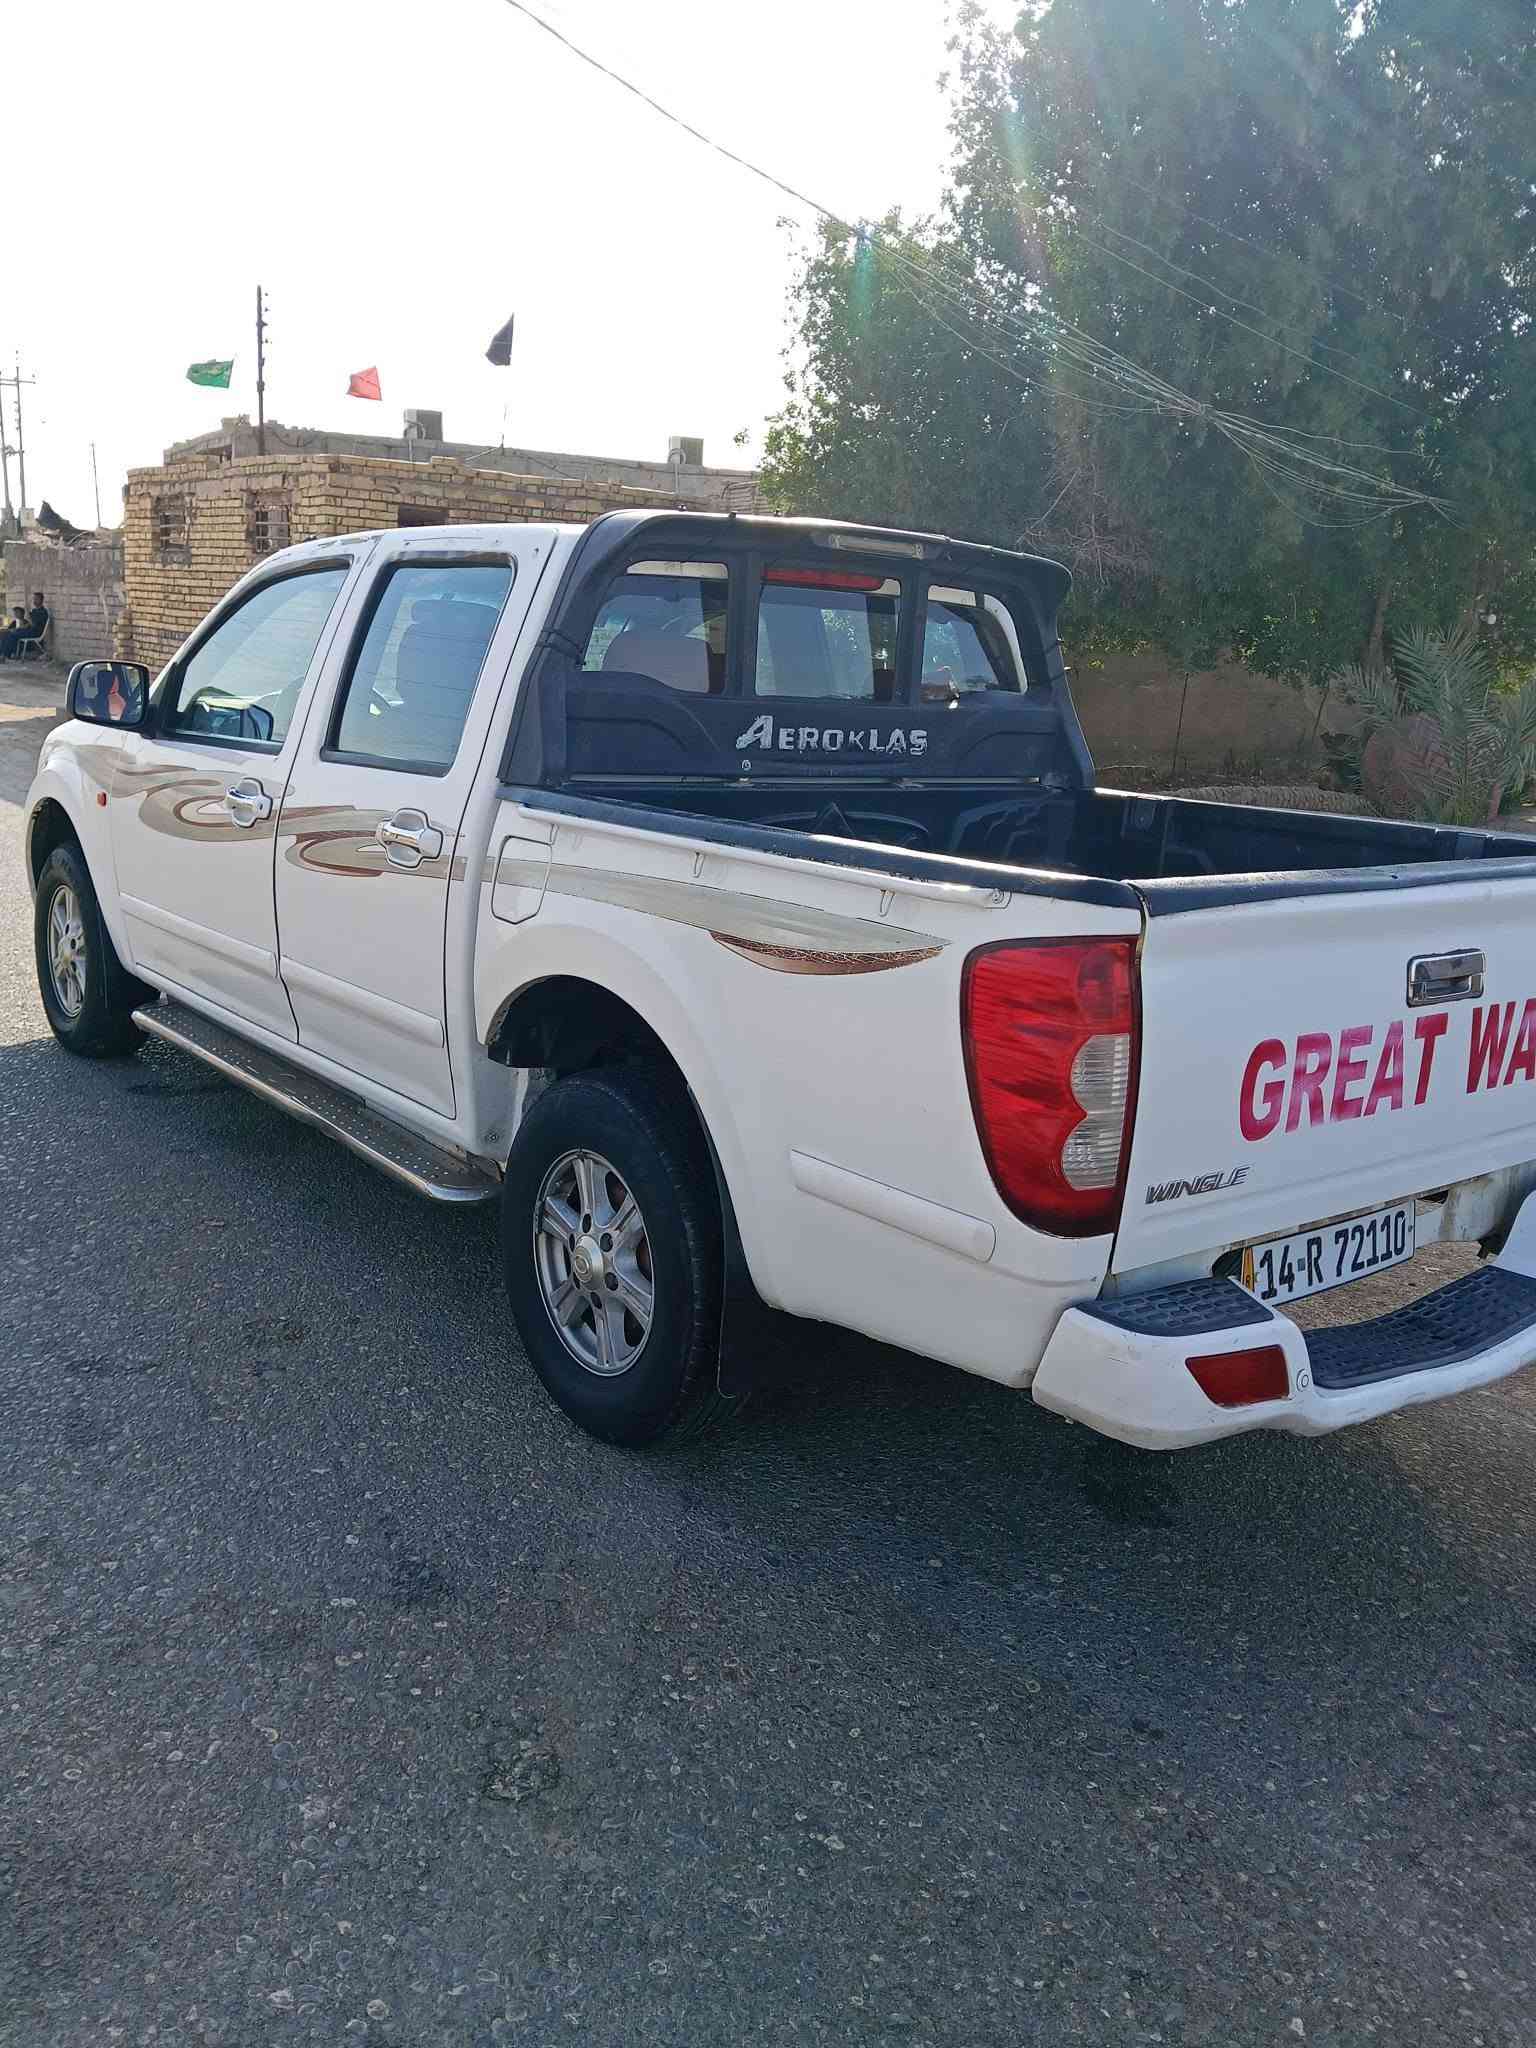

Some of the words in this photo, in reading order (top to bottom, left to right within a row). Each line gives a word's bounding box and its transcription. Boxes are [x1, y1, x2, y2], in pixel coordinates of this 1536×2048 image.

[1239, 1012, 1449, 1142] GREAT
[1144, 1166, 1250, 1204] WINGLE
[1334, 1210, 1406, 1277] 72110
